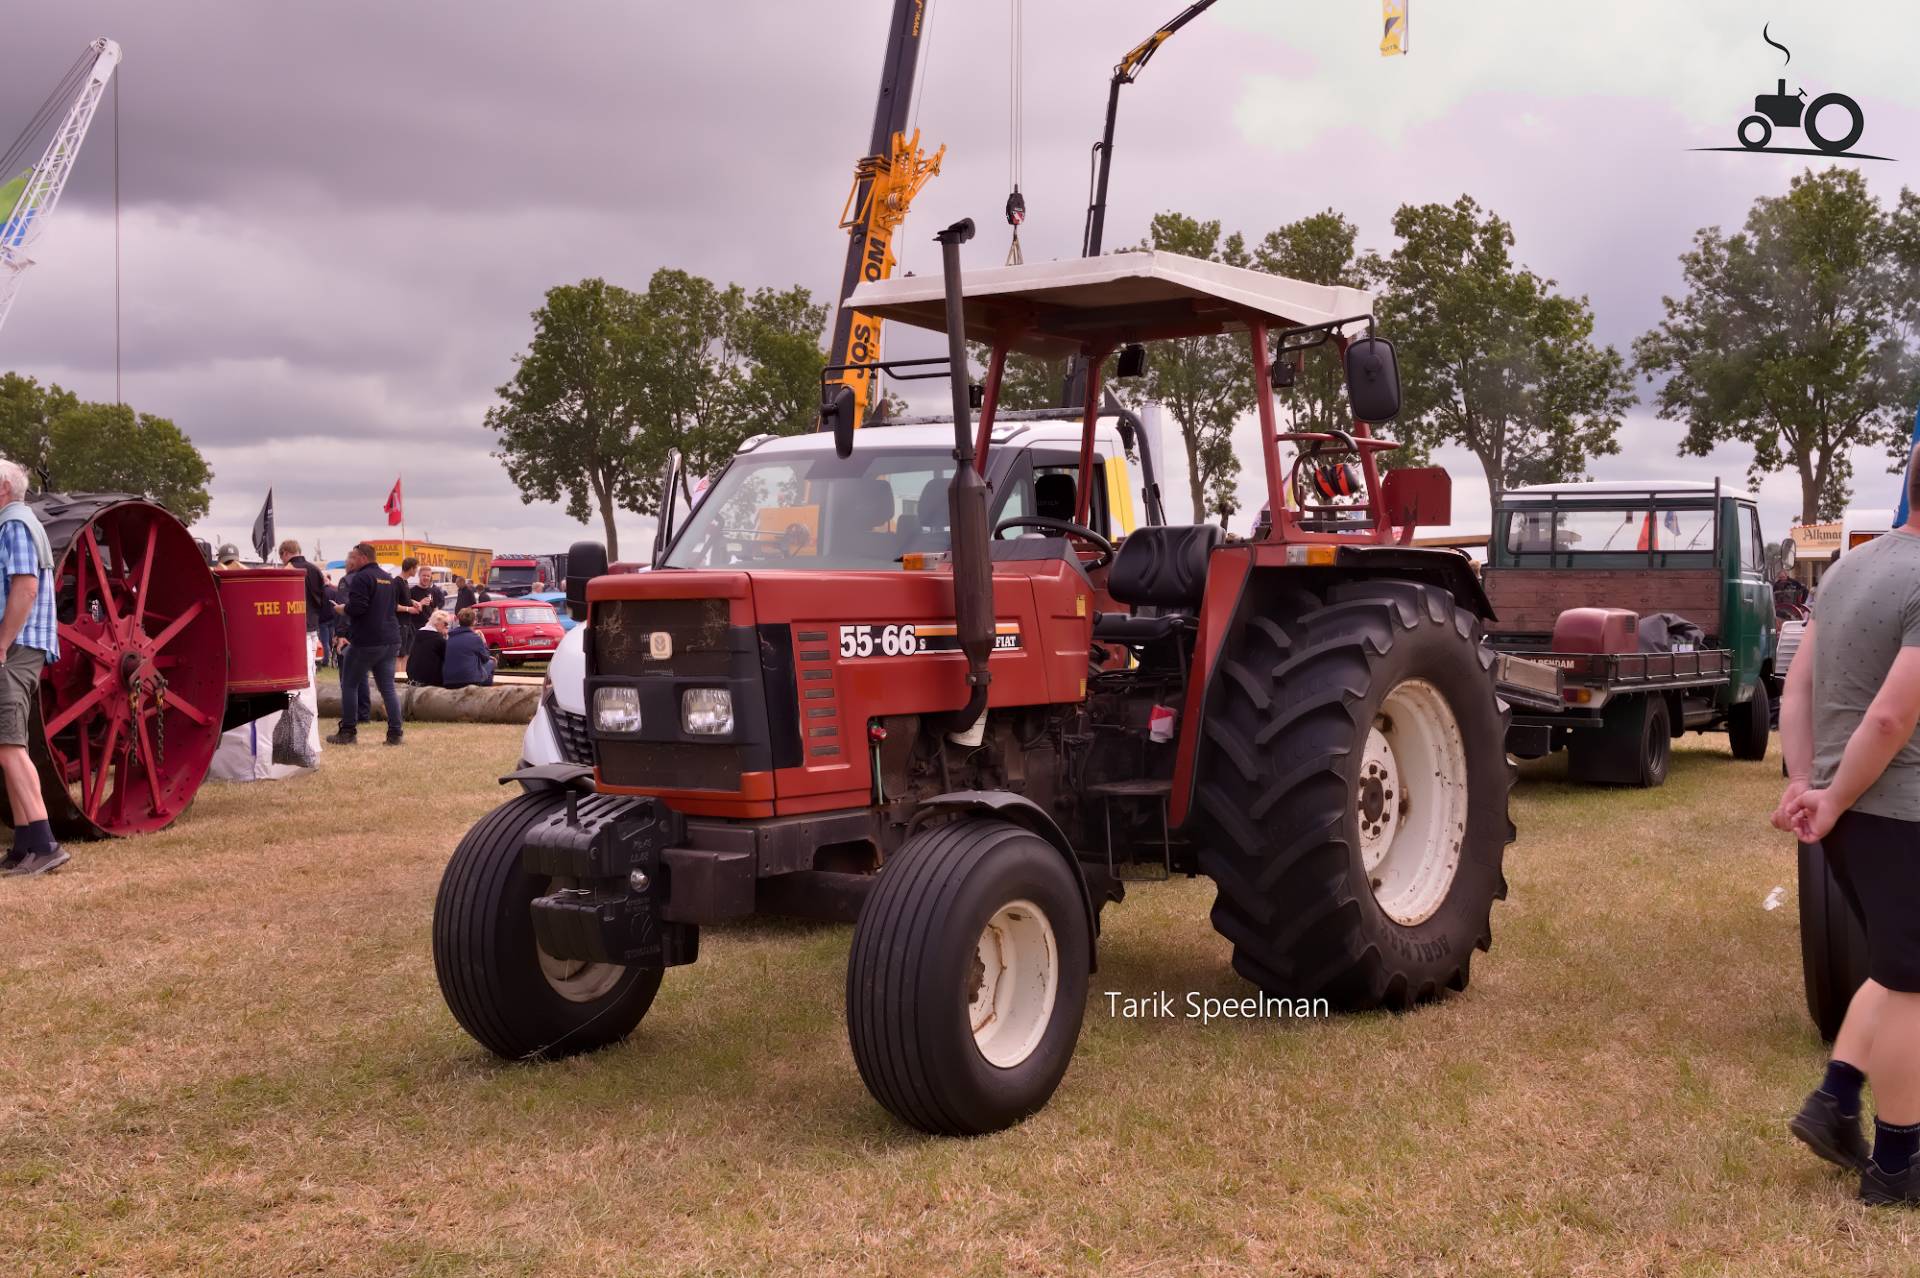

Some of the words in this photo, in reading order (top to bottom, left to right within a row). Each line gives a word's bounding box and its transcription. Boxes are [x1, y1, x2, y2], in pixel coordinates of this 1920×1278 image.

[865, 237, 886, 283] OM
[254, 601, 280, 616] THE
[839, 624, 917, 657] 55-66
[995, 635, 1017, 648] FIAT
